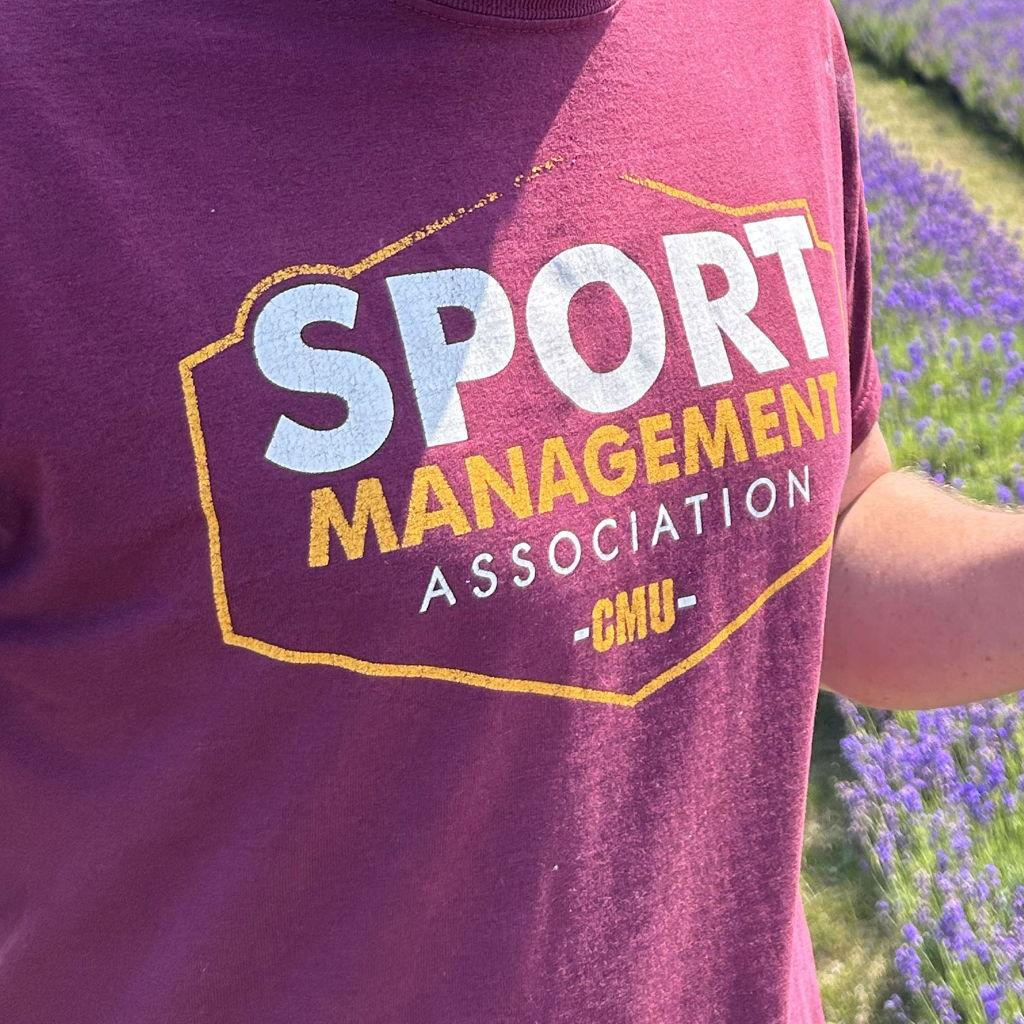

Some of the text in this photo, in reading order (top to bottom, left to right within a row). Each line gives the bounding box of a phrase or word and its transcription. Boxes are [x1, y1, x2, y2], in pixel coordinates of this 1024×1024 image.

[252, 213, 830, 475] SPORT
[308, 371, 842, 568] MANAGEMENT
[418, 465, 813, 614] ASSOCIATION
